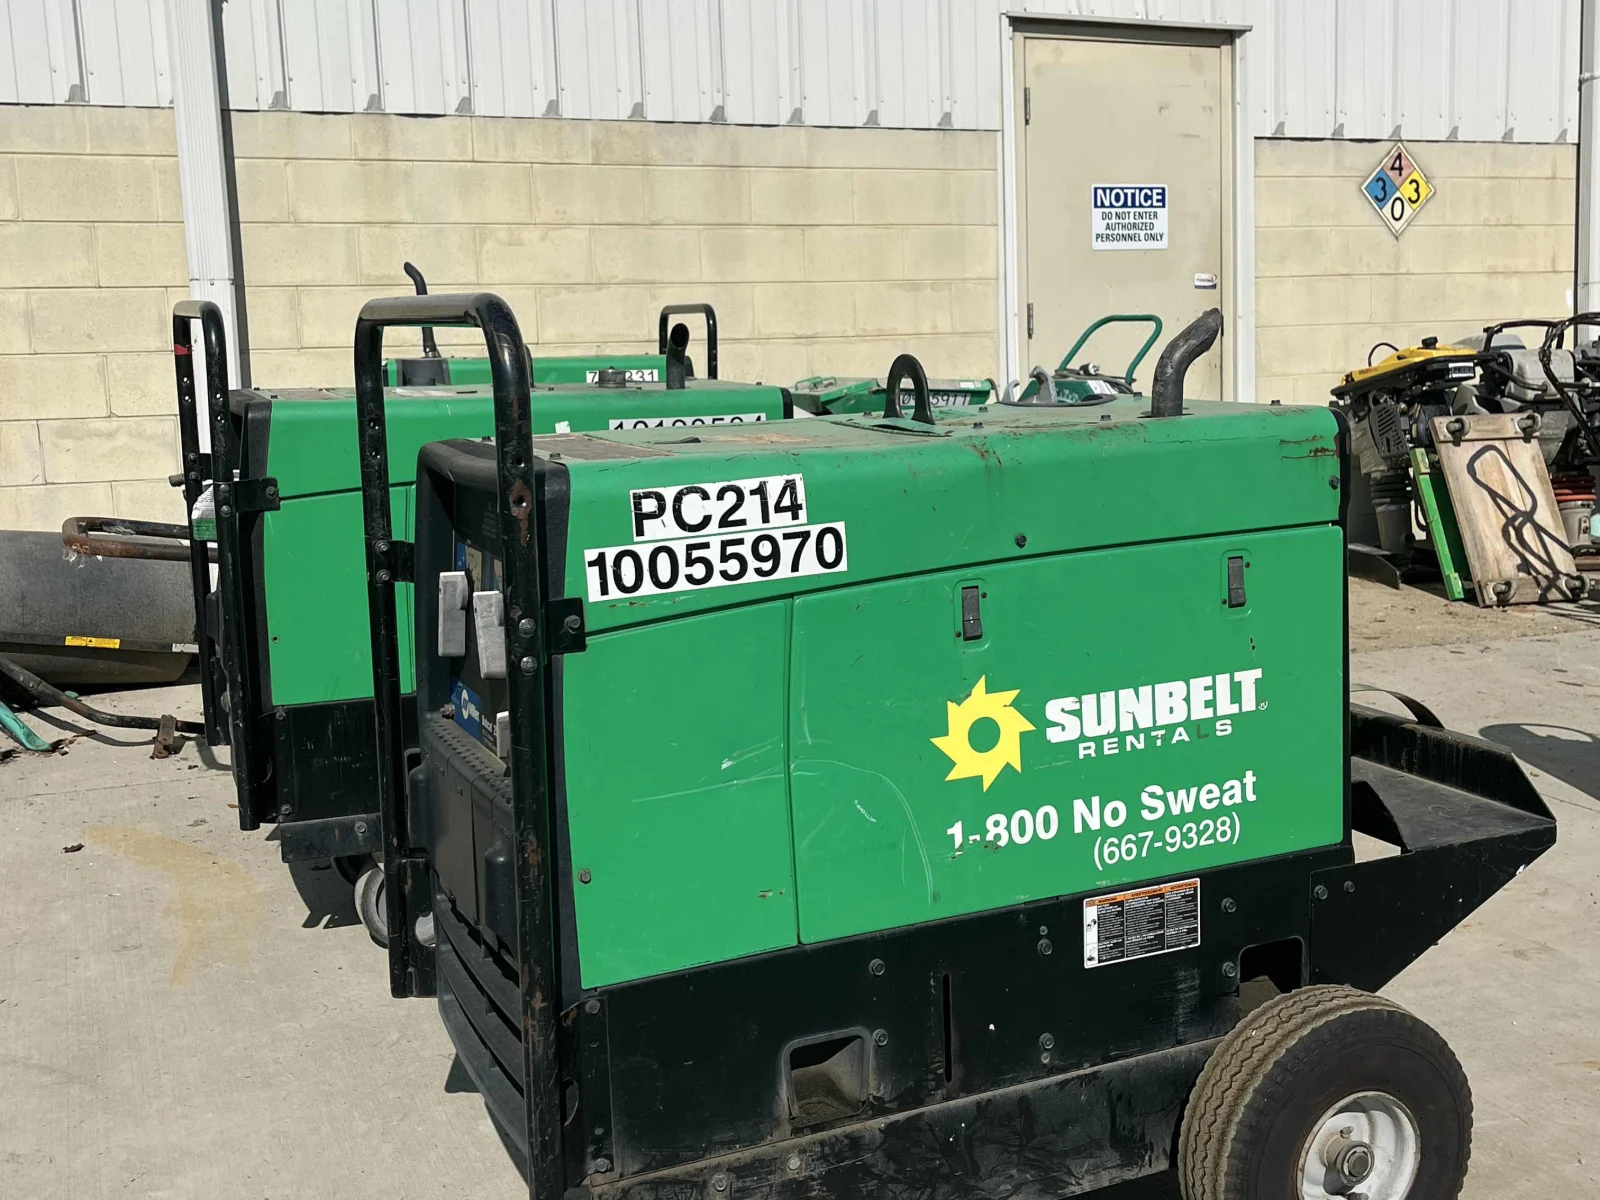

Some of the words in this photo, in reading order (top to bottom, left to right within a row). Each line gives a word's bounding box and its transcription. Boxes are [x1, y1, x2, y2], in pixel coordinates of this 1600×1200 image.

[1389, 151, 1404, 177] 4
[1096, 188, 1163, 207] NOTICE
[1374, 176, 1387, 203] 3
[1407, 178, 1421, 204] 3
[1101, 211, 1113, 220] DO
[1115, 211, 1131, 220] NOT
[1133, 211, 1158, 220] ENTER
[1390, 196, 1405, 221] 0
[1095, 232, 1142, 242] PERSONNEL
[1143, 232, 1164, 241] ONLY
[1105, 221, 1155, 231] AUTHORIZED
[631, 478, 803, 537] PC214
[587, 526, 844, 596] 10055970
[1045, 668, 1263, 744] SUNBELT
[1078, 719, 1233, 760] RENTALS
[946, 804, 1059, 858] 1-800
[1073, 795, 1128, 834] No
[1140, 770, 1257, 821] Sweat
[1093, 811, 1241, 870] (667-9328)
